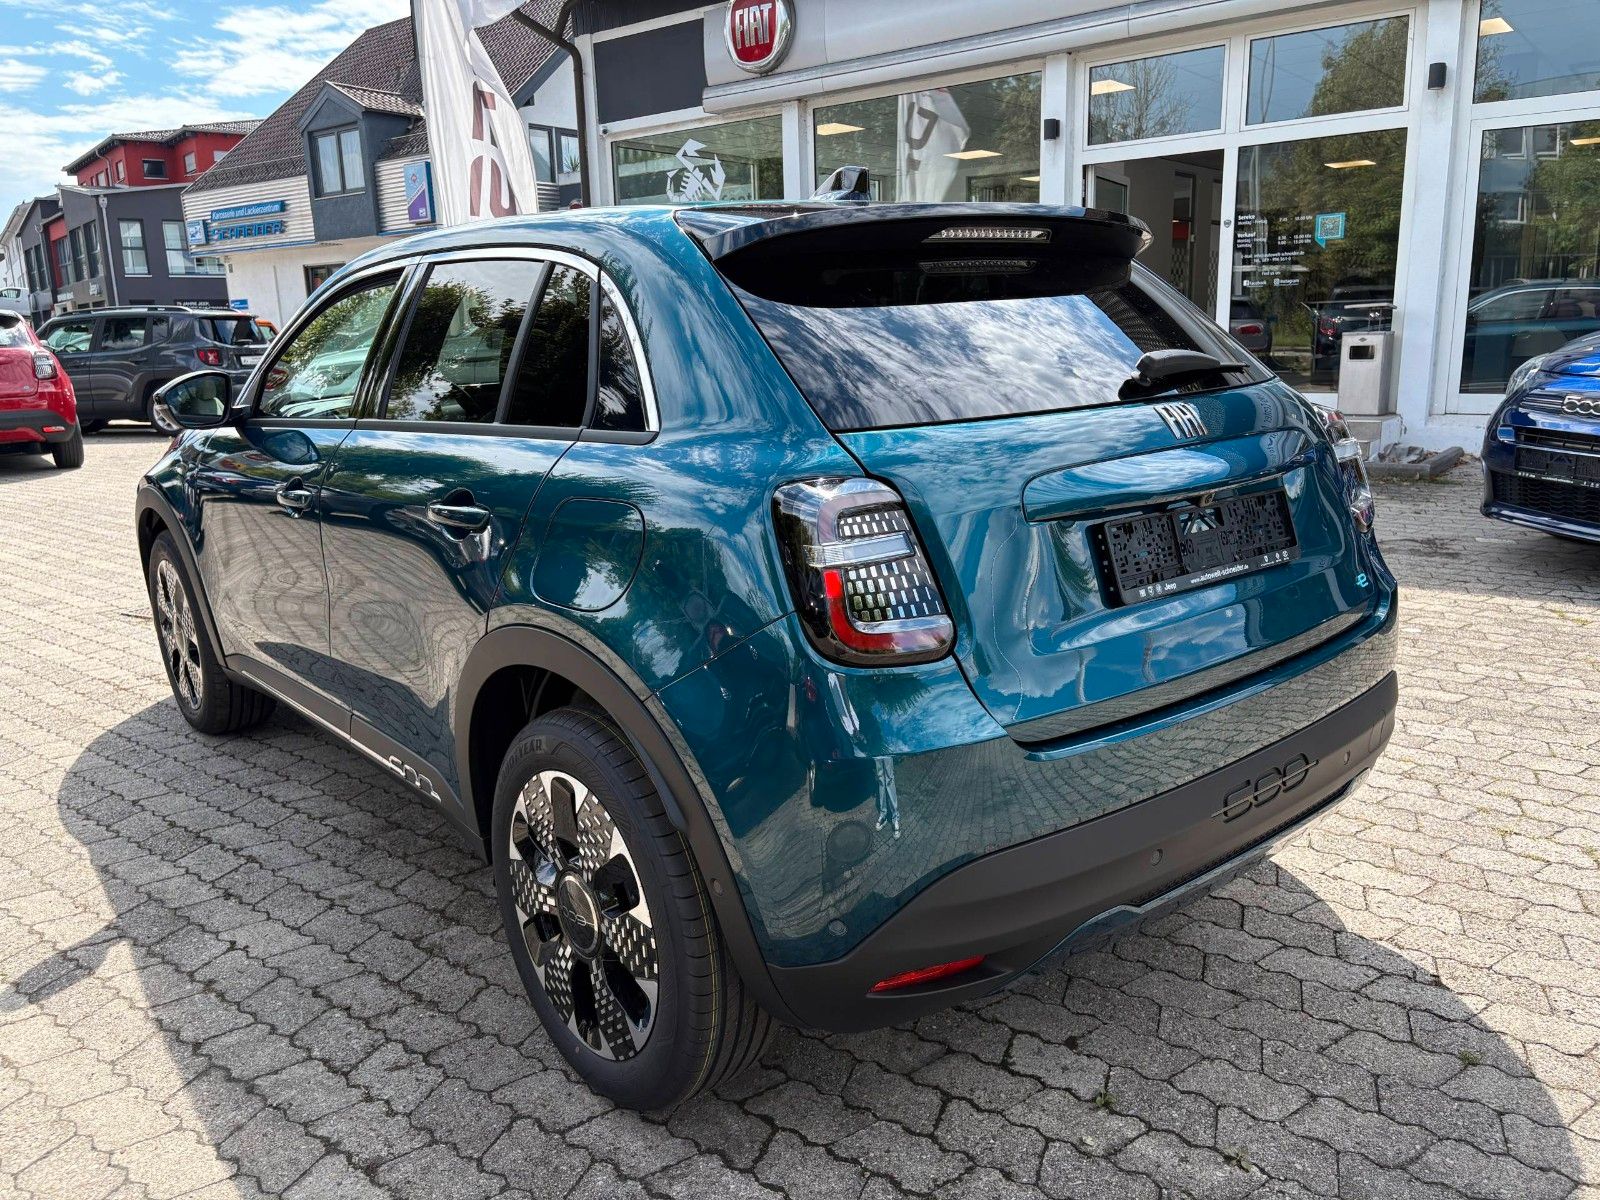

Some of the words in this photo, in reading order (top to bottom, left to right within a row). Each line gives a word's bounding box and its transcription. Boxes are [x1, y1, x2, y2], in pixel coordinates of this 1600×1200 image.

[735, 2, 773, 49] FIAT
[235, 207, 245, 217] und
[1153, 402, 1208, 440] FIAT
[1164, 582, 1177, 592] Jeep
